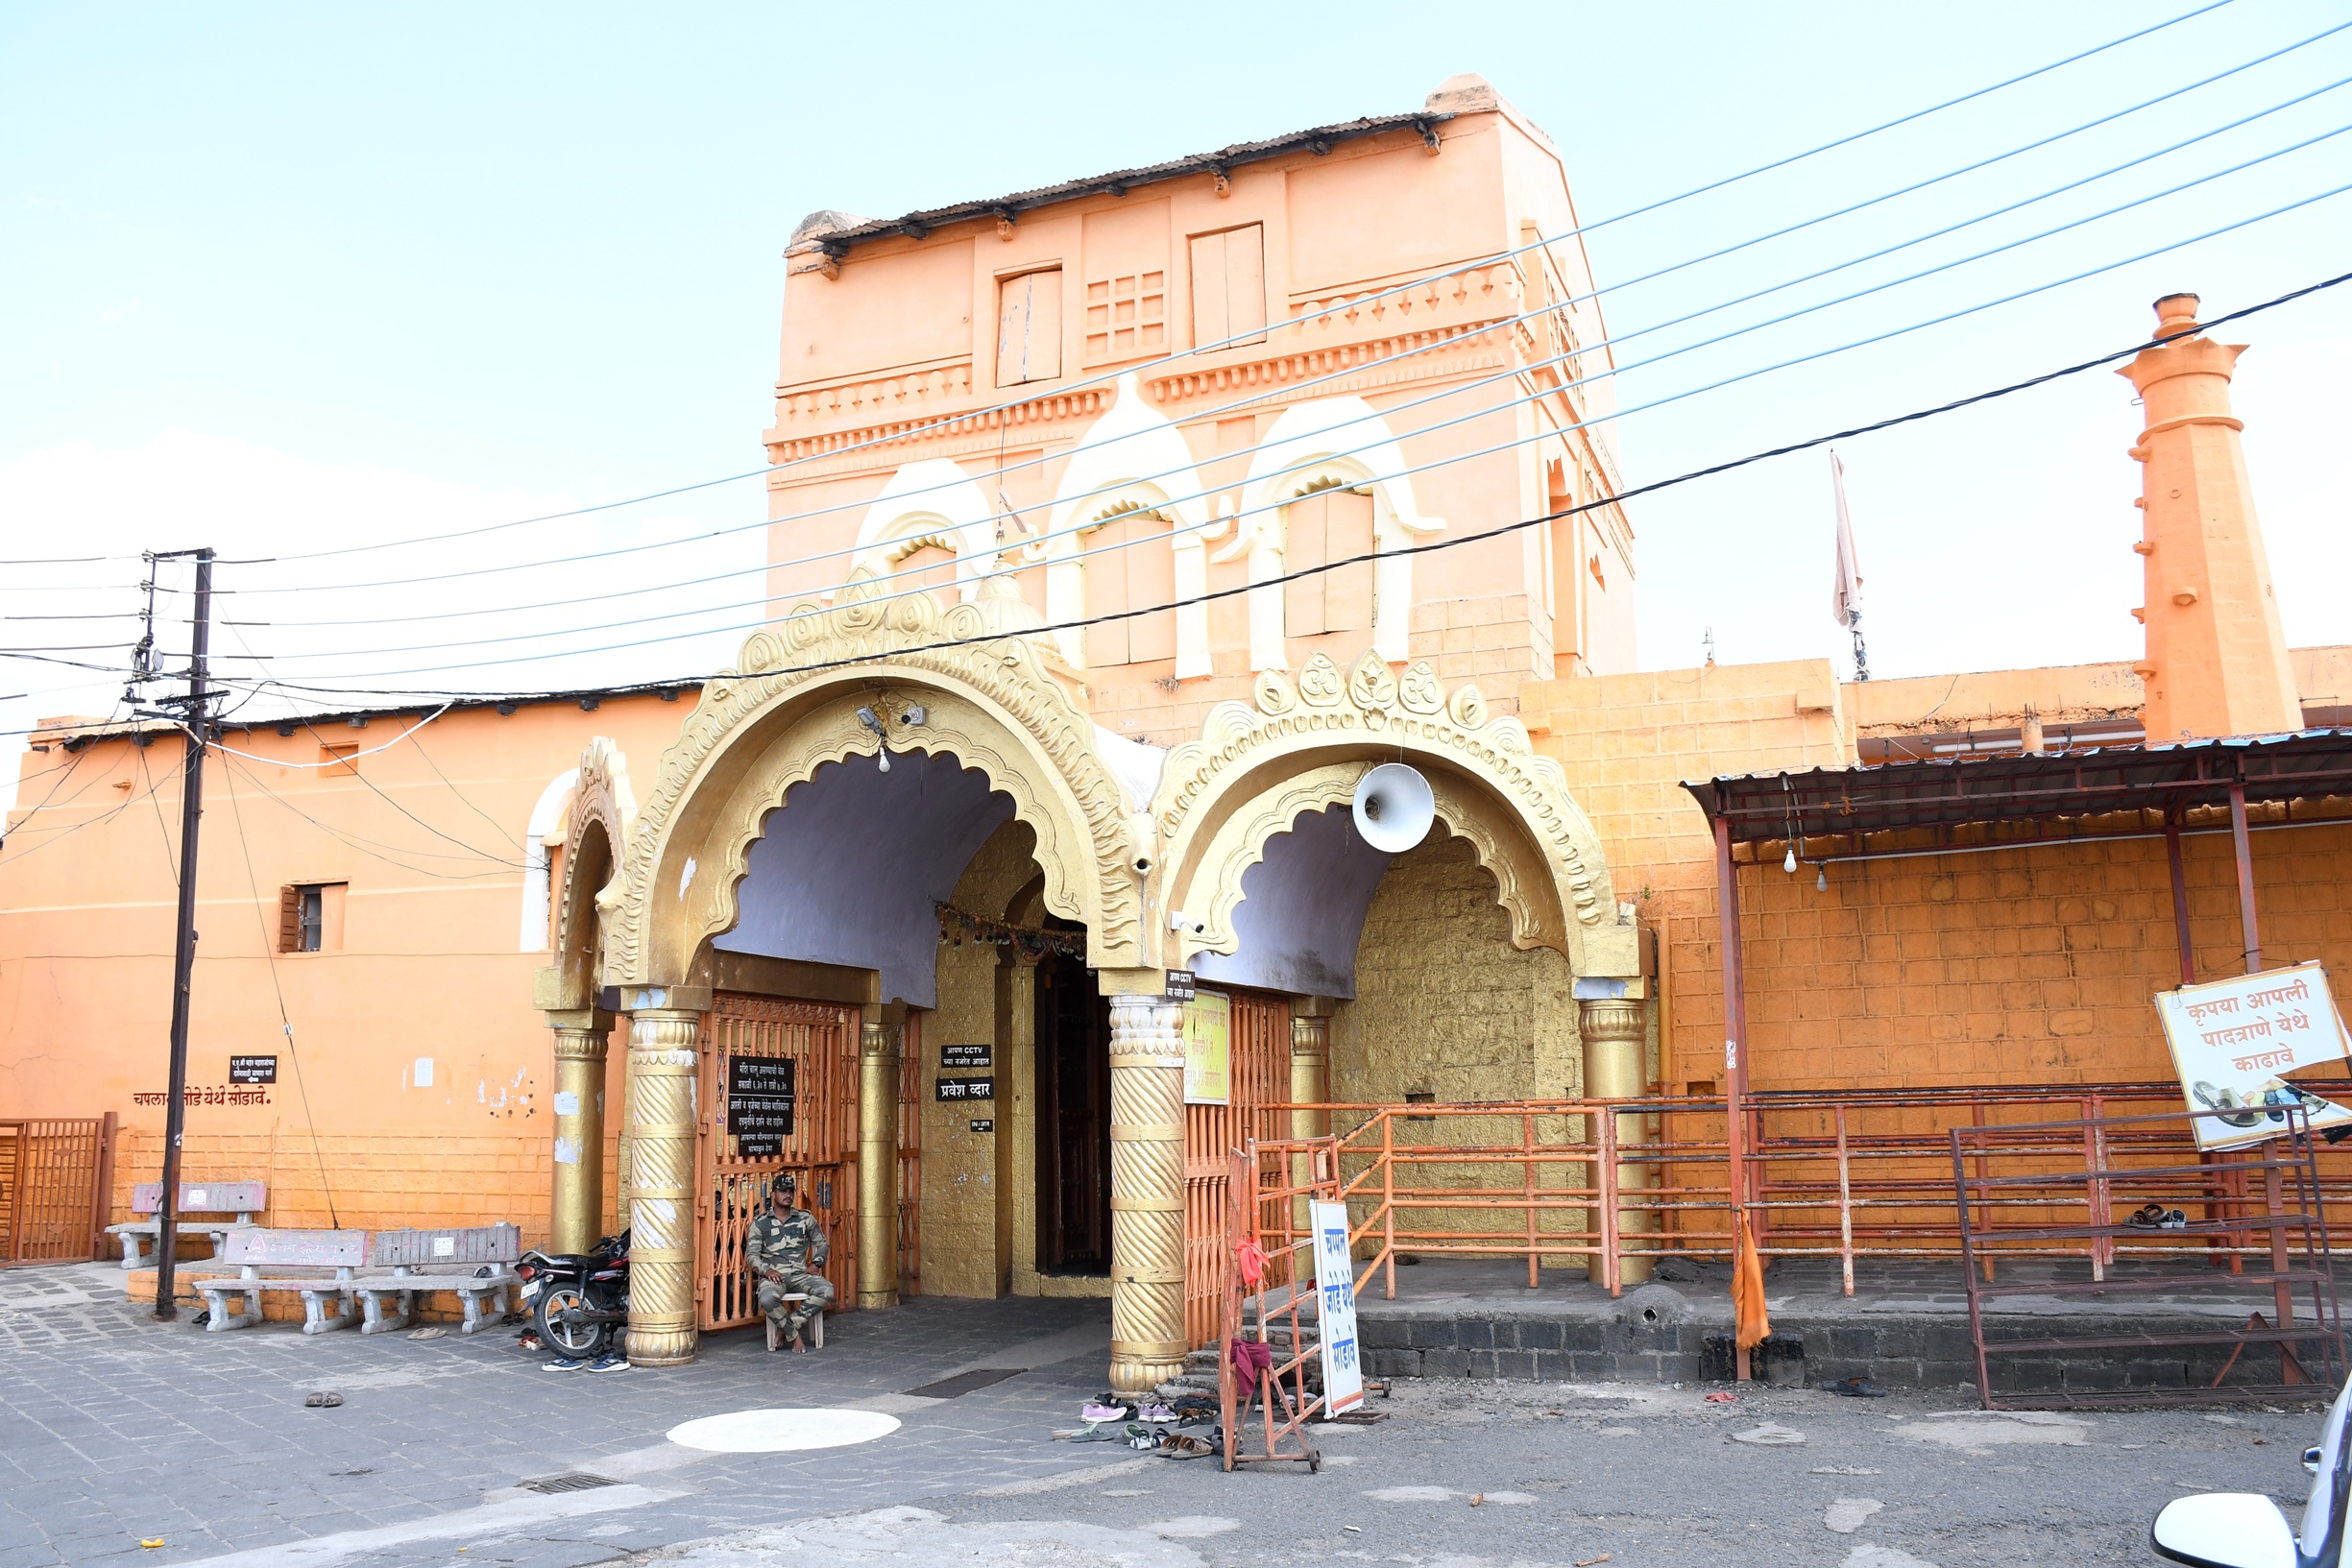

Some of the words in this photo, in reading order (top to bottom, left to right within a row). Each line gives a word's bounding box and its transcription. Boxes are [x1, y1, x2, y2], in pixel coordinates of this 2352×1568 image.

[1180, 974, 1191, 982] CCTV
[2185, 998, 2240, 1026] कृपया
[2247, 978, 2309, 1009] आपली
[2201, 1016, 2272, 1047] पादत्राणे
[2276, 1008, 2310, 1032] येथे
[955, 1056, 970, 1065] नजरेत
[2232, 1043, 2294, 1072] काढावे
[738, 1078, 751, 1090] सकाळी
[764, 1079, 766, 1090] ते
[941, 1080, 965, 1098] प्रवेश
[205, 1085, 226, 1105] येथे
[228, 1085, 271, 1106] सोडावे.
[731, 1098, 741, 1110] आरती
[743, 1100, 746, 1110] व
[756, 1115, 764, 1126] दर्शन
[1324, 1229, 1345, 1258] चप्पल
[1324, 1270, 1340, 1315] जोडे
[1342, 1269, 1354, 1313] येथे
[1332, 1325, 1356, 1372] सोडावे
